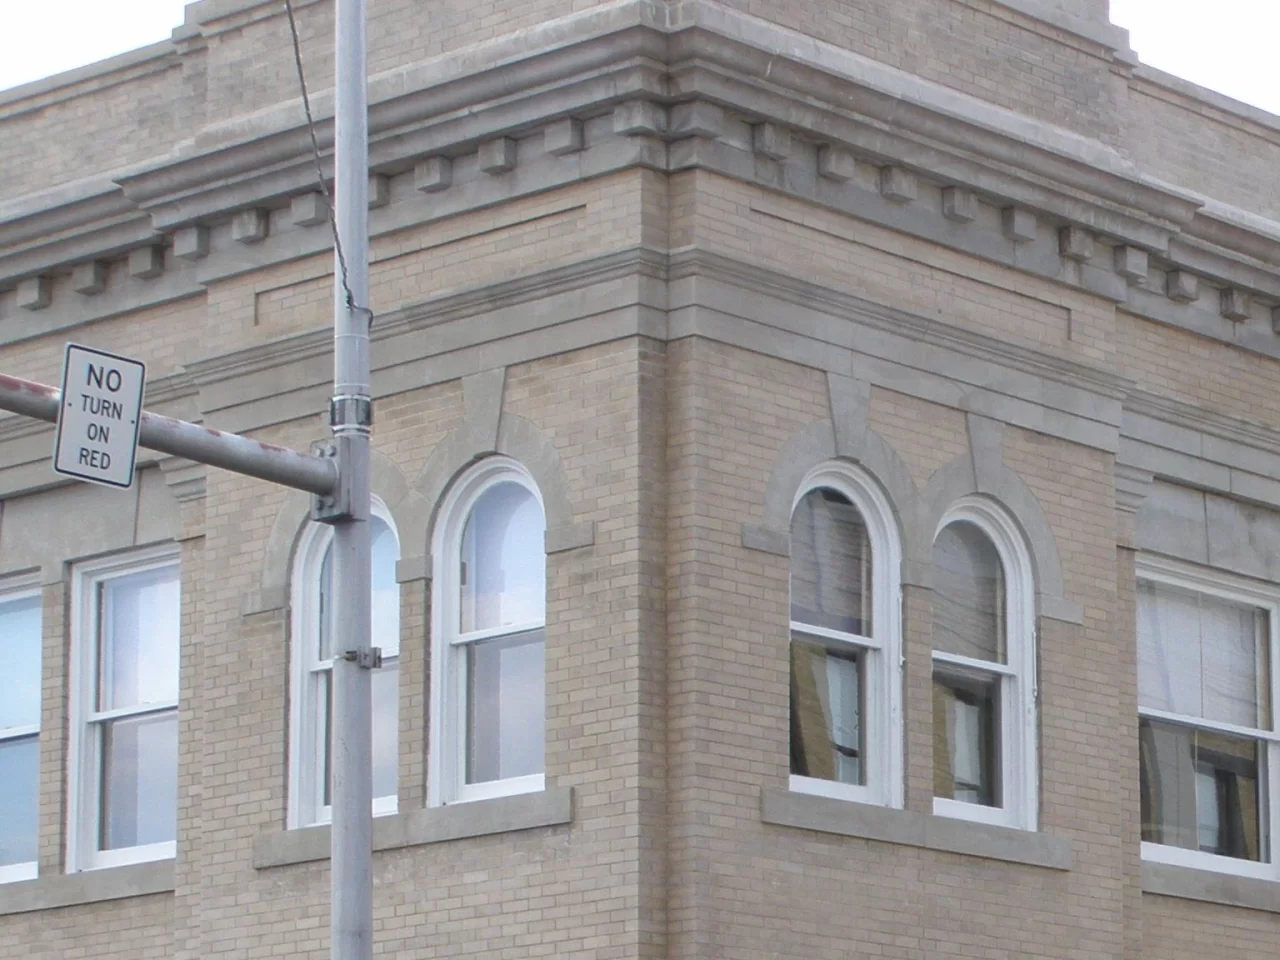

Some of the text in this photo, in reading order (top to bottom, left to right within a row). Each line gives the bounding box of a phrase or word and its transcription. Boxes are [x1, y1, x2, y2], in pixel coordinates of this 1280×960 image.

[87, 364, 122, 392] NO
[82, 394, 122, 420] TURN
[87, 423, 110, 443] ON
[79, 448, 111, 470] RED
